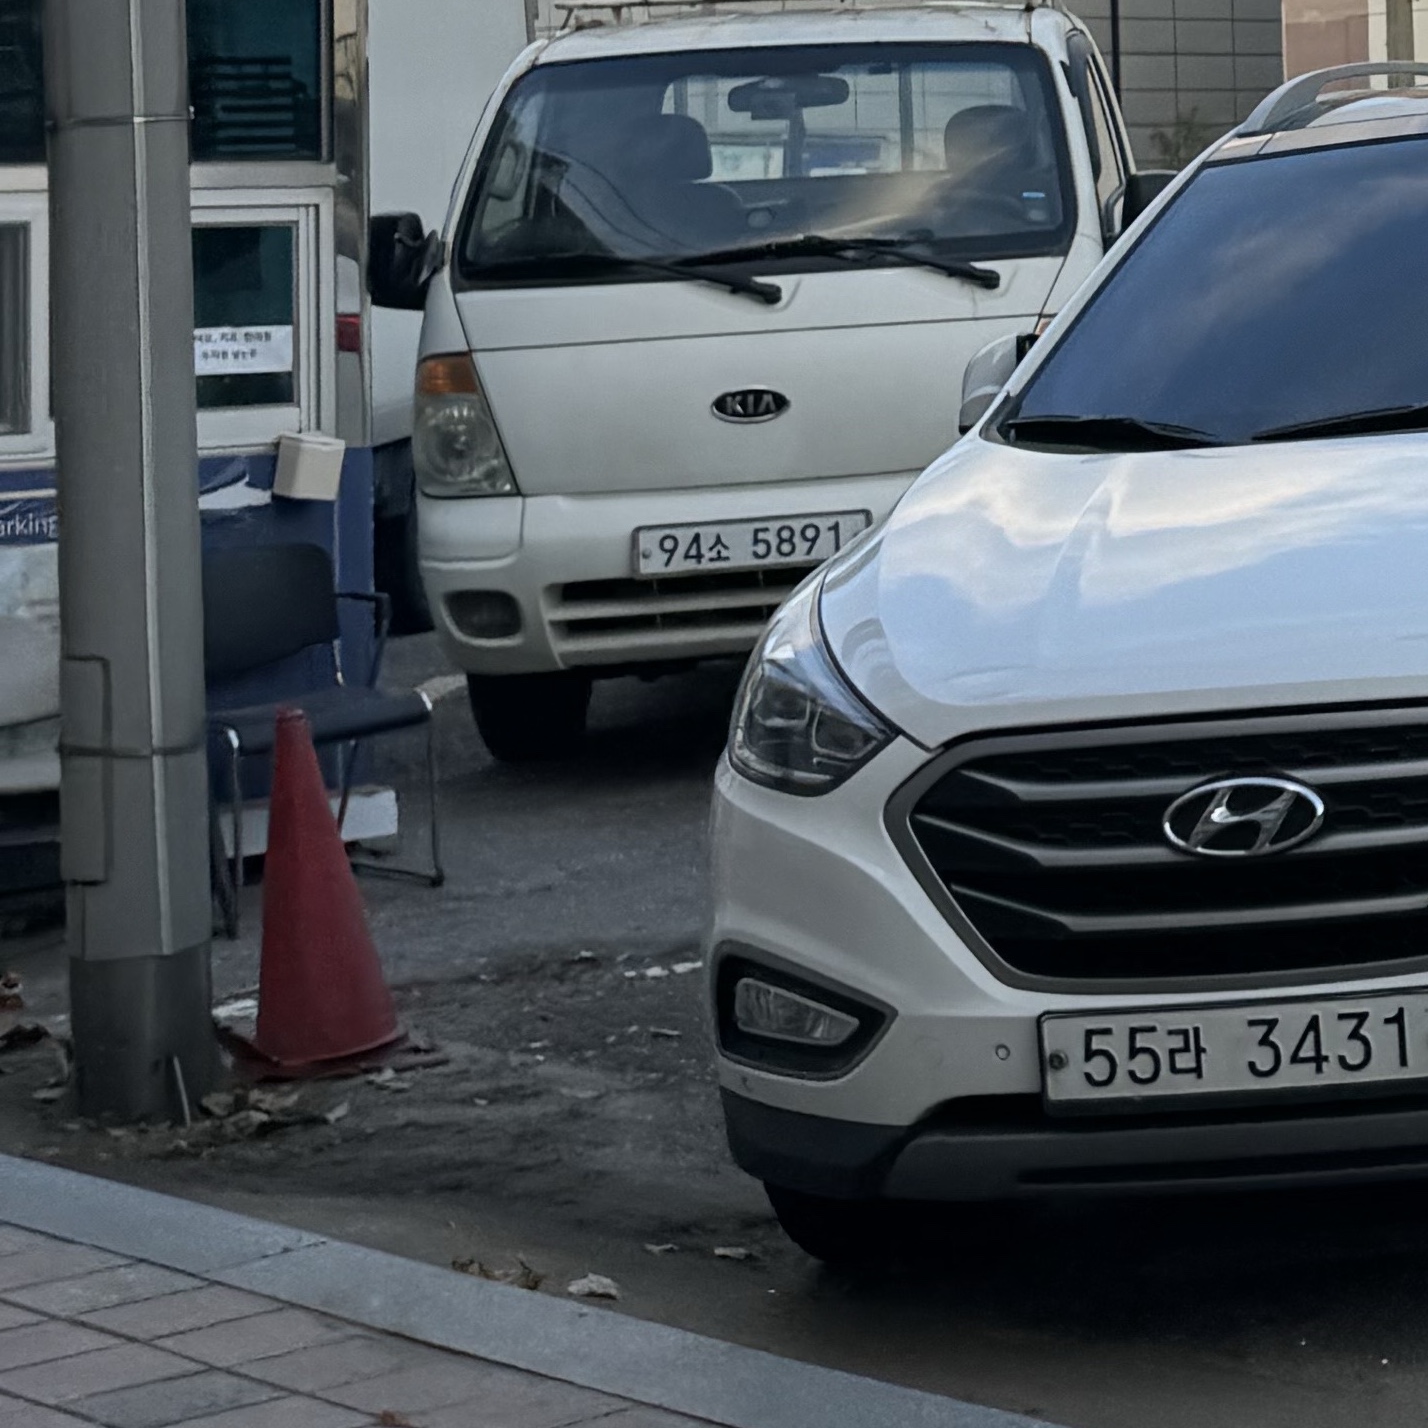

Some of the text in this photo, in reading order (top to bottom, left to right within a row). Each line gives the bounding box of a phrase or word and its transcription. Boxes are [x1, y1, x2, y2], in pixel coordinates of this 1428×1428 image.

[726, 393, 776, 414] KIA
[659, 520, 841, 568] 94소 5891
[1083, 1006, 1409, 1088] 55라 3431
